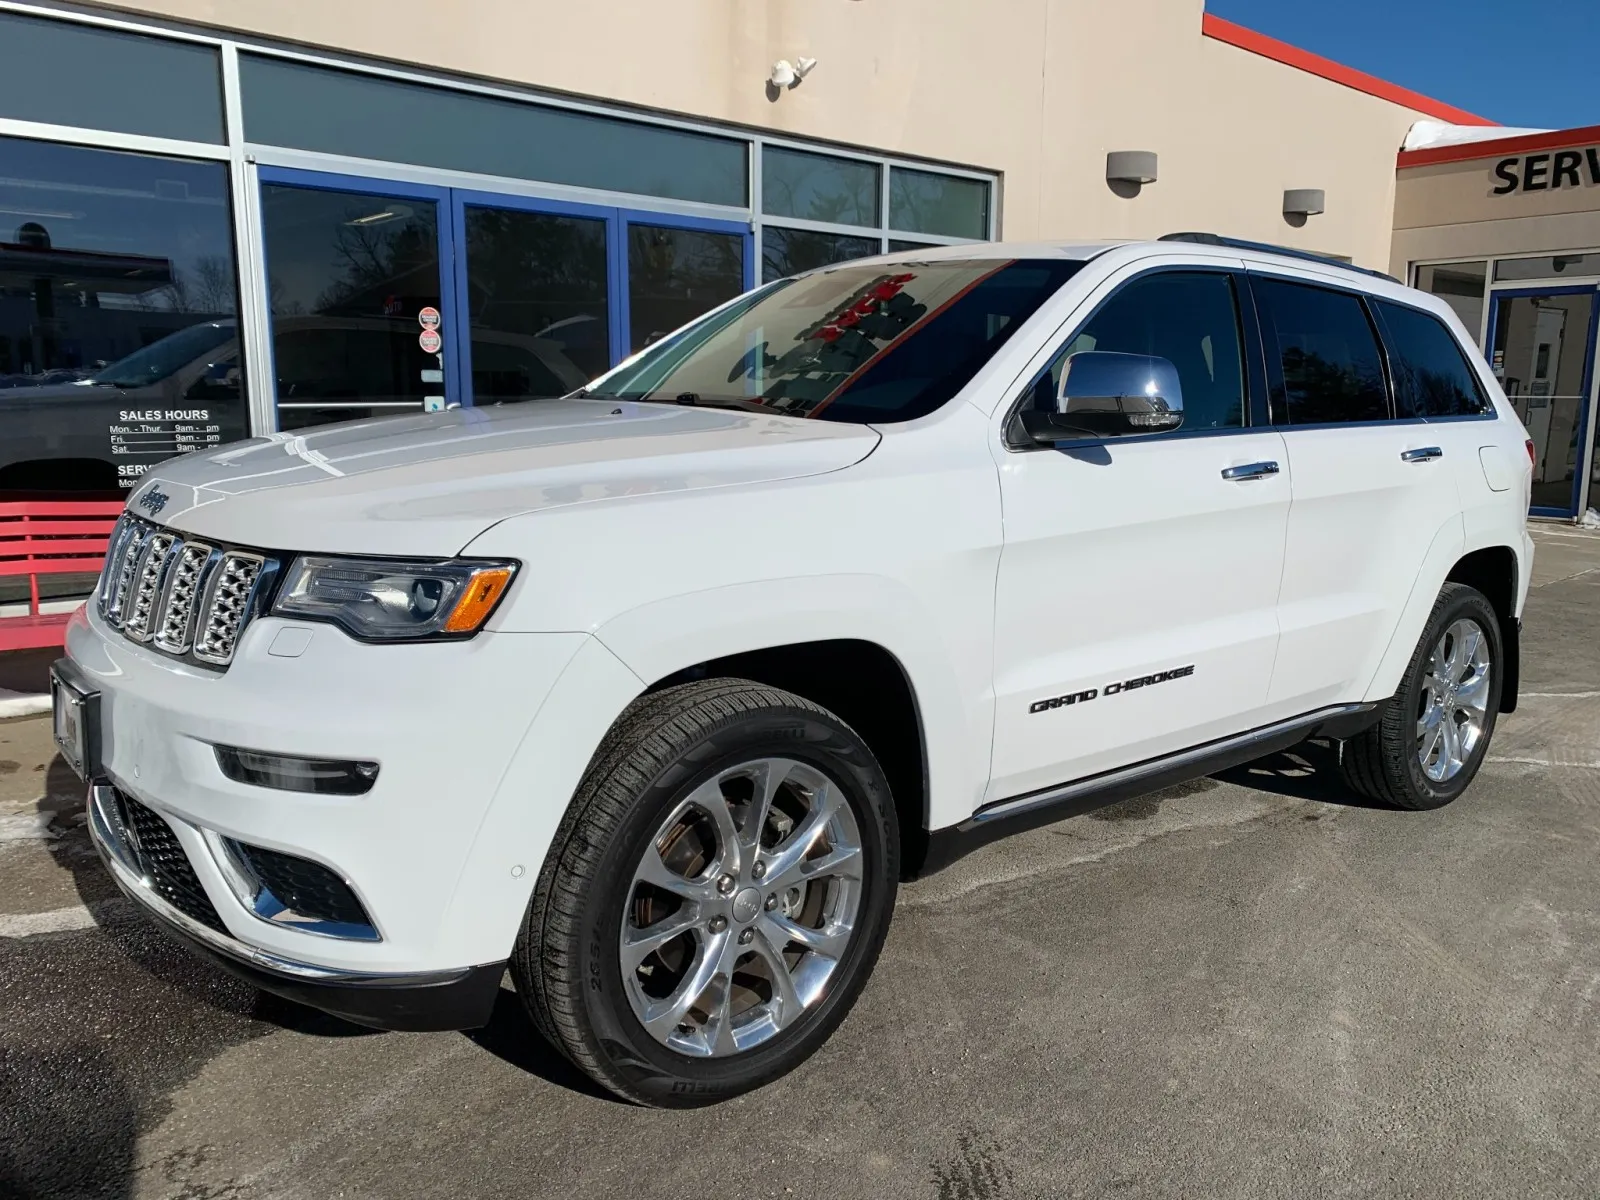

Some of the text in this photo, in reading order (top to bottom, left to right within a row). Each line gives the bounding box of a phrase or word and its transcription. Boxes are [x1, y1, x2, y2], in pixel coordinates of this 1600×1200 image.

[119, 410, 209, 420] SALES HOURS
[109, 425, 132, 433] Mon.
[175, 424, 194, 432] 9am
[206, 425, 219, 433] pm
[110, 435, 125, 443] Fri.
[206, 434, 220, 442] pm
[111, 445, 130, 454] Sat.
[176, 444, 196, 452] 9am
[1029, 664, 1195, 714] GRAND CHEROKEE
